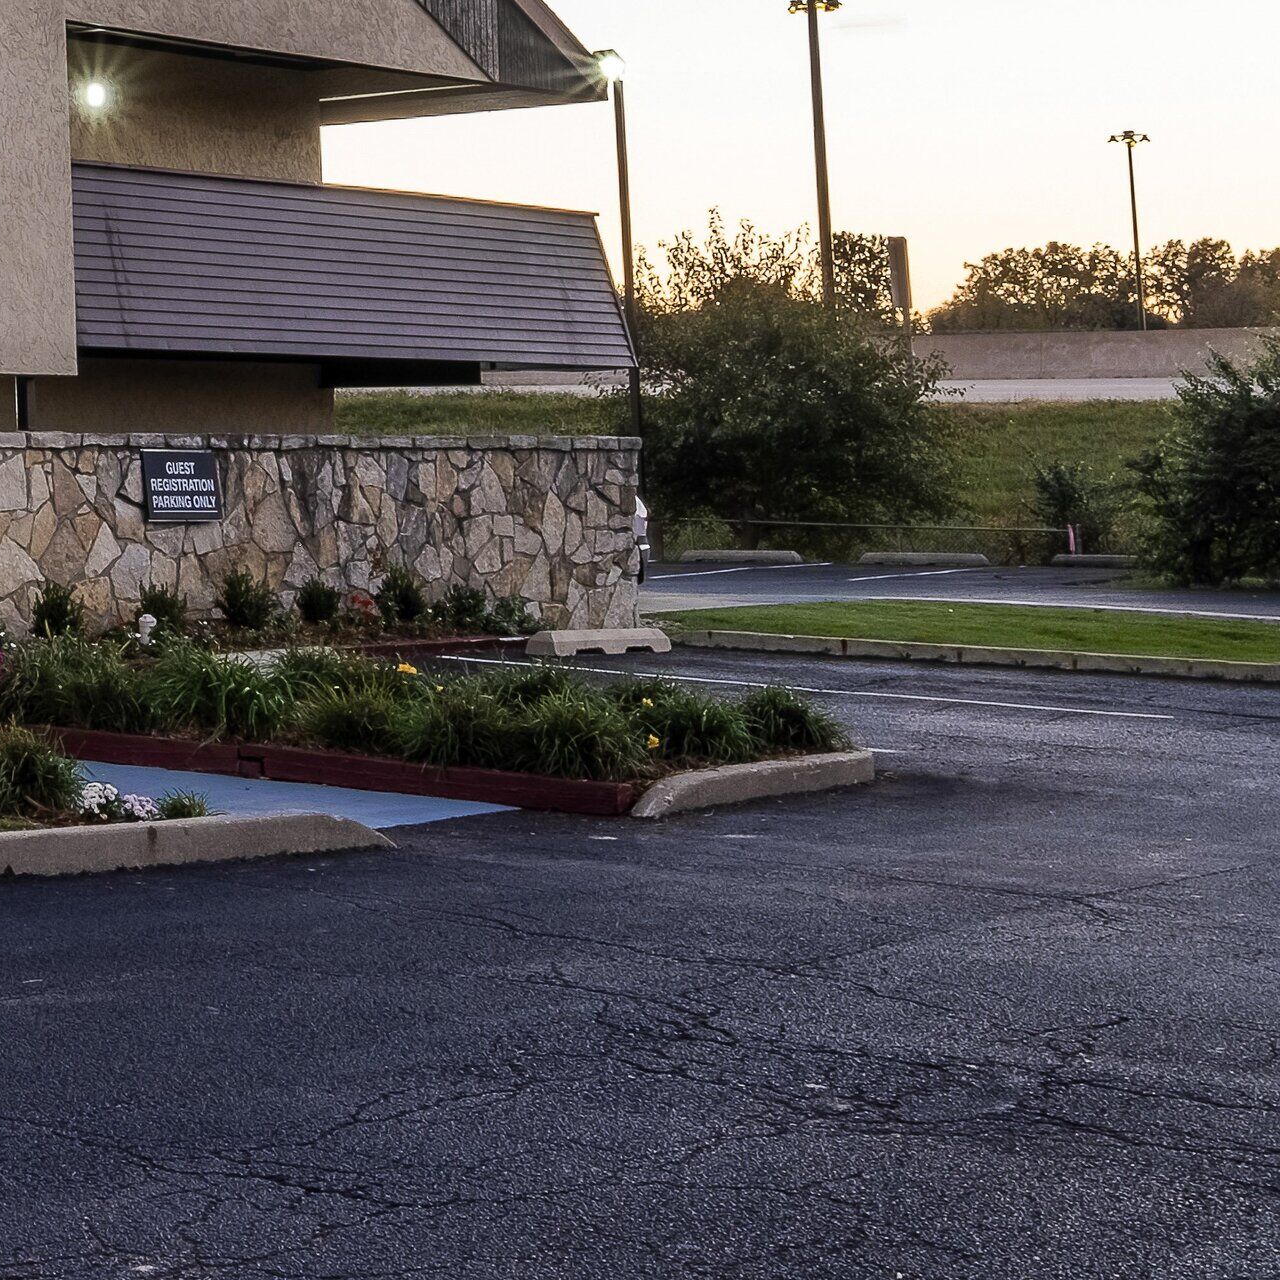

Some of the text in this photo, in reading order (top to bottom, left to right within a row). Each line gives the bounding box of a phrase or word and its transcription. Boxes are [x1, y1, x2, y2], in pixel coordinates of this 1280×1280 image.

[165, 461, 195, 475] GUEST
[150, 478, 215, 492] REGISTRATION
[152, 495, 216, 508] PARKING ONLY
